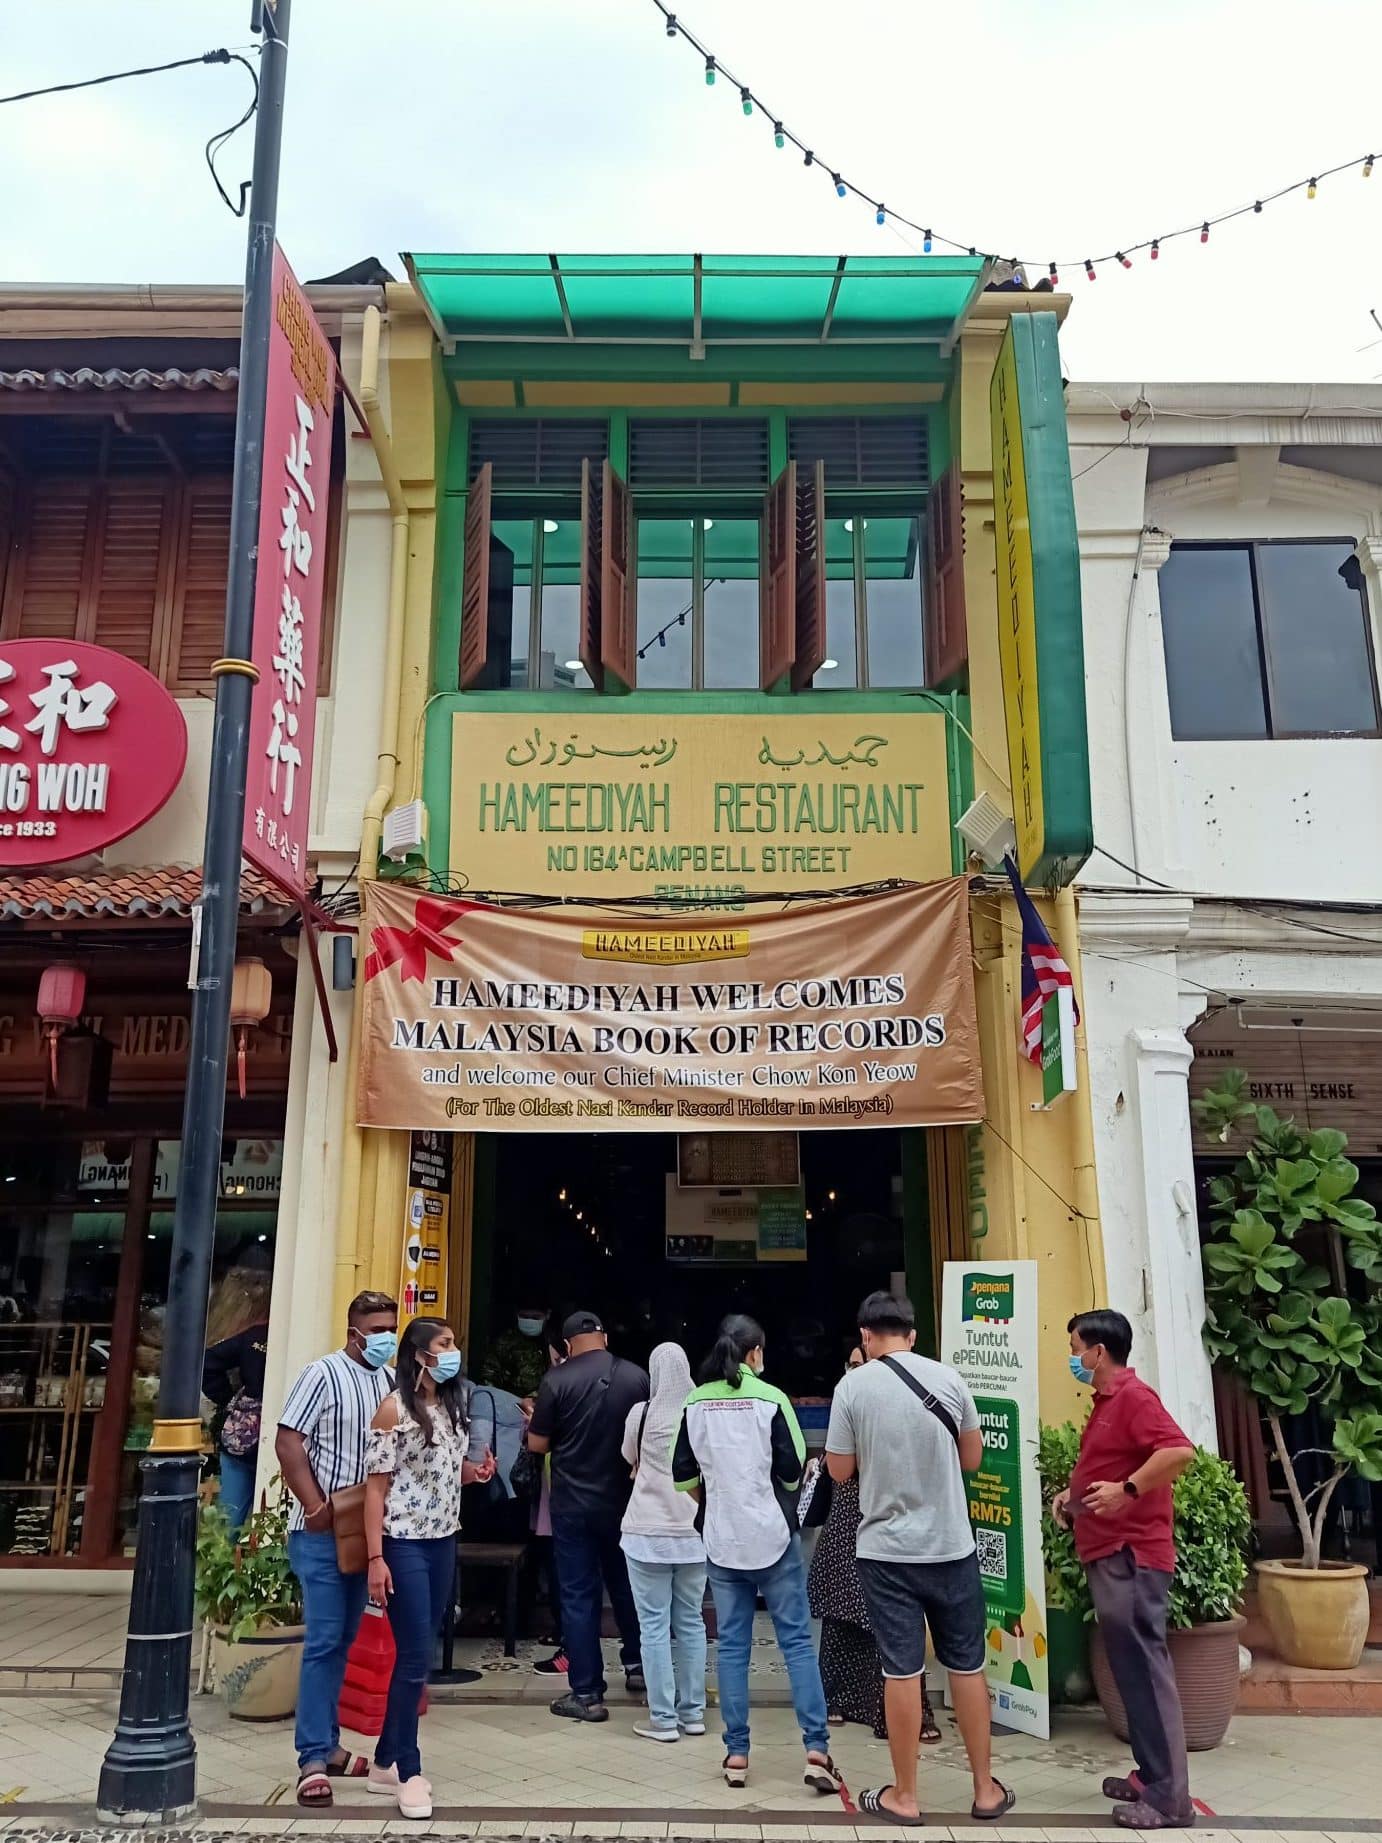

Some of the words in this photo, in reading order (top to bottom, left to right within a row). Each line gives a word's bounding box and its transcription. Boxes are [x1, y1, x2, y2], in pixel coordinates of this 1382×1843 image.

[999, 367, 1033, 828] HAMEEDIYAH
[37, 763, 108, 812] WOH
[479, 783, 670, 832] HAMEEDIYAH
[714, 783, 925, 833] RESTAURANT
[16, 821, 57, 837] 1933
[255, 806, 300, 873] 有限公司
[547, 846, 578, 872] NO
[629, 846, 755, 872] CAMPBELL
[762, 846, 851, 873] STREET
[596, 934, 736, 952] HAMEEDIYAH
[432, 978, 680, 1012] HAMEEDIYAH
[690, 976, 905, 1012] WELCOMES
[394, 1020, 584, 1053] MALAYSIA
[592, 1026, 698, 1055] BOOK
[710, 1025, 758, 1054] OF
[767, 1016, 945, 1052] RECORDS
[422, 1064, 460, 1084] and
[468, 1064, 556, 1085] welcome
[563, 1070, 597, 1086] our
[604, 1066, 655, 1086] Chief
[663, 1067, 744, 1087] Minister
[752, 1066, 810, 1086] Chow
[819, 1064, 857, 1083] Kon
[864, 1061, 916, 1082] Yeow
[1250, 1083, 1294, 1099] SIXTH
[1310, 1083, 1356, 1099] SENSE
[445, 1098, 478, 1118] (For
[483, 1098, 514, 1117] The
[519, 1098, 573, 1118] Oldest
[577, 1099, 613, 1118] Nasi
[617, 1100, 673, 1118] Kandar
[678, 1099, 734, 1118] Record
[738, 1098, 794, 1117] Holder
[799, 1098, 815, 1116] In
[819, 1093, 894, 1119] Malaysia)
[976, 1297, 1000, 1310] Grab
[965, 1329, 1009, 1347] Tuntut
[970, 1501, 1012, 1527] RM75
